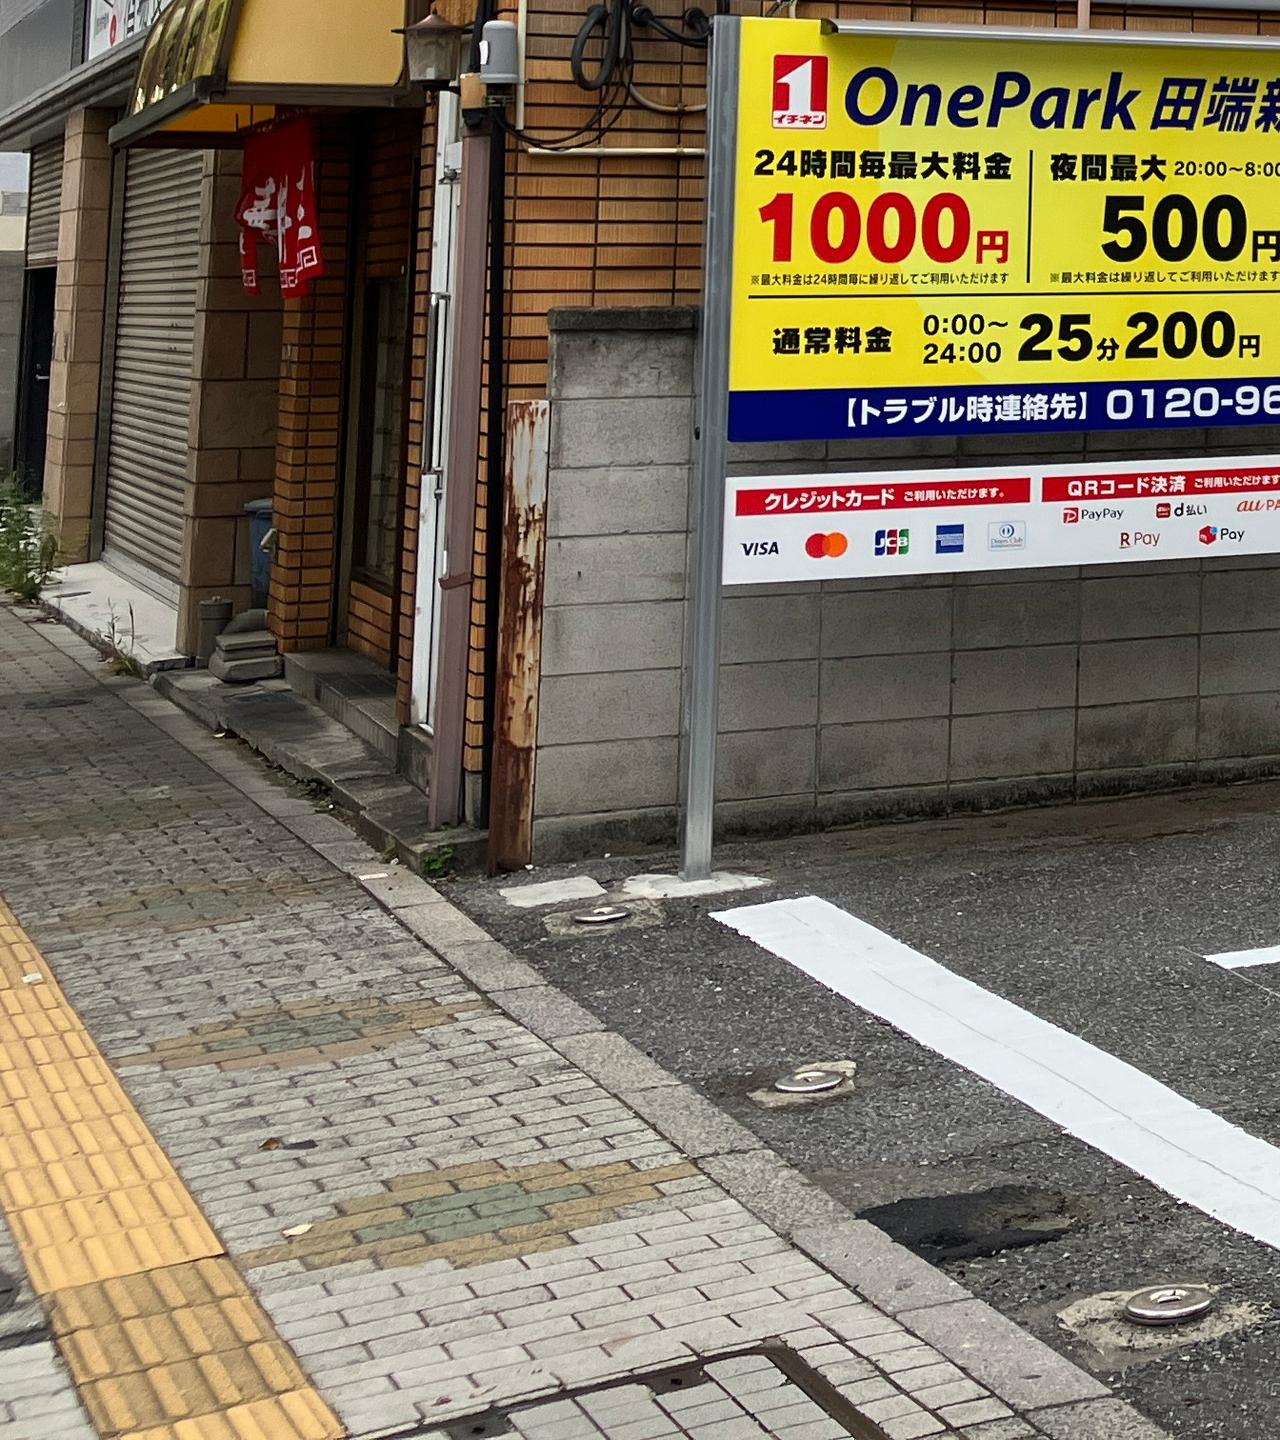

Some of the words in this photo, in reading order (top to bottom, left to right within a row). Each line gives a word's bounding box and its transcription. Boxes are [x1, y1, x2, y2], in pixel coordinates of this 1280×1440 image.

[844, 65, 1141, 131] OnePark
[773, 113, 825, 126] イチネン
[754, 149, 1013, 182] 24時間毎最大料金
[1050, 153, 1167, 183] 夜間最大
[757, 190, 1010, 265] 1000円
[772, 325, 893, 356] 通常料金
[923, 342, 1002, 365] 24:00
[847, 391, 1088, 428] 【トラブル時連絡先】
[1066, 475, 1187, 497] QRコード決済
[764, 488, 896, 511] クレジットカード
[903, 487, 1005, 502] ご利用いただけます。
[1081, 508, 1124, 520] PayPay
[1133, 531, 1161, 547] Pay
[1220, 527, 1245, 542] Pay
[740, 541, 780, 556] VISA
